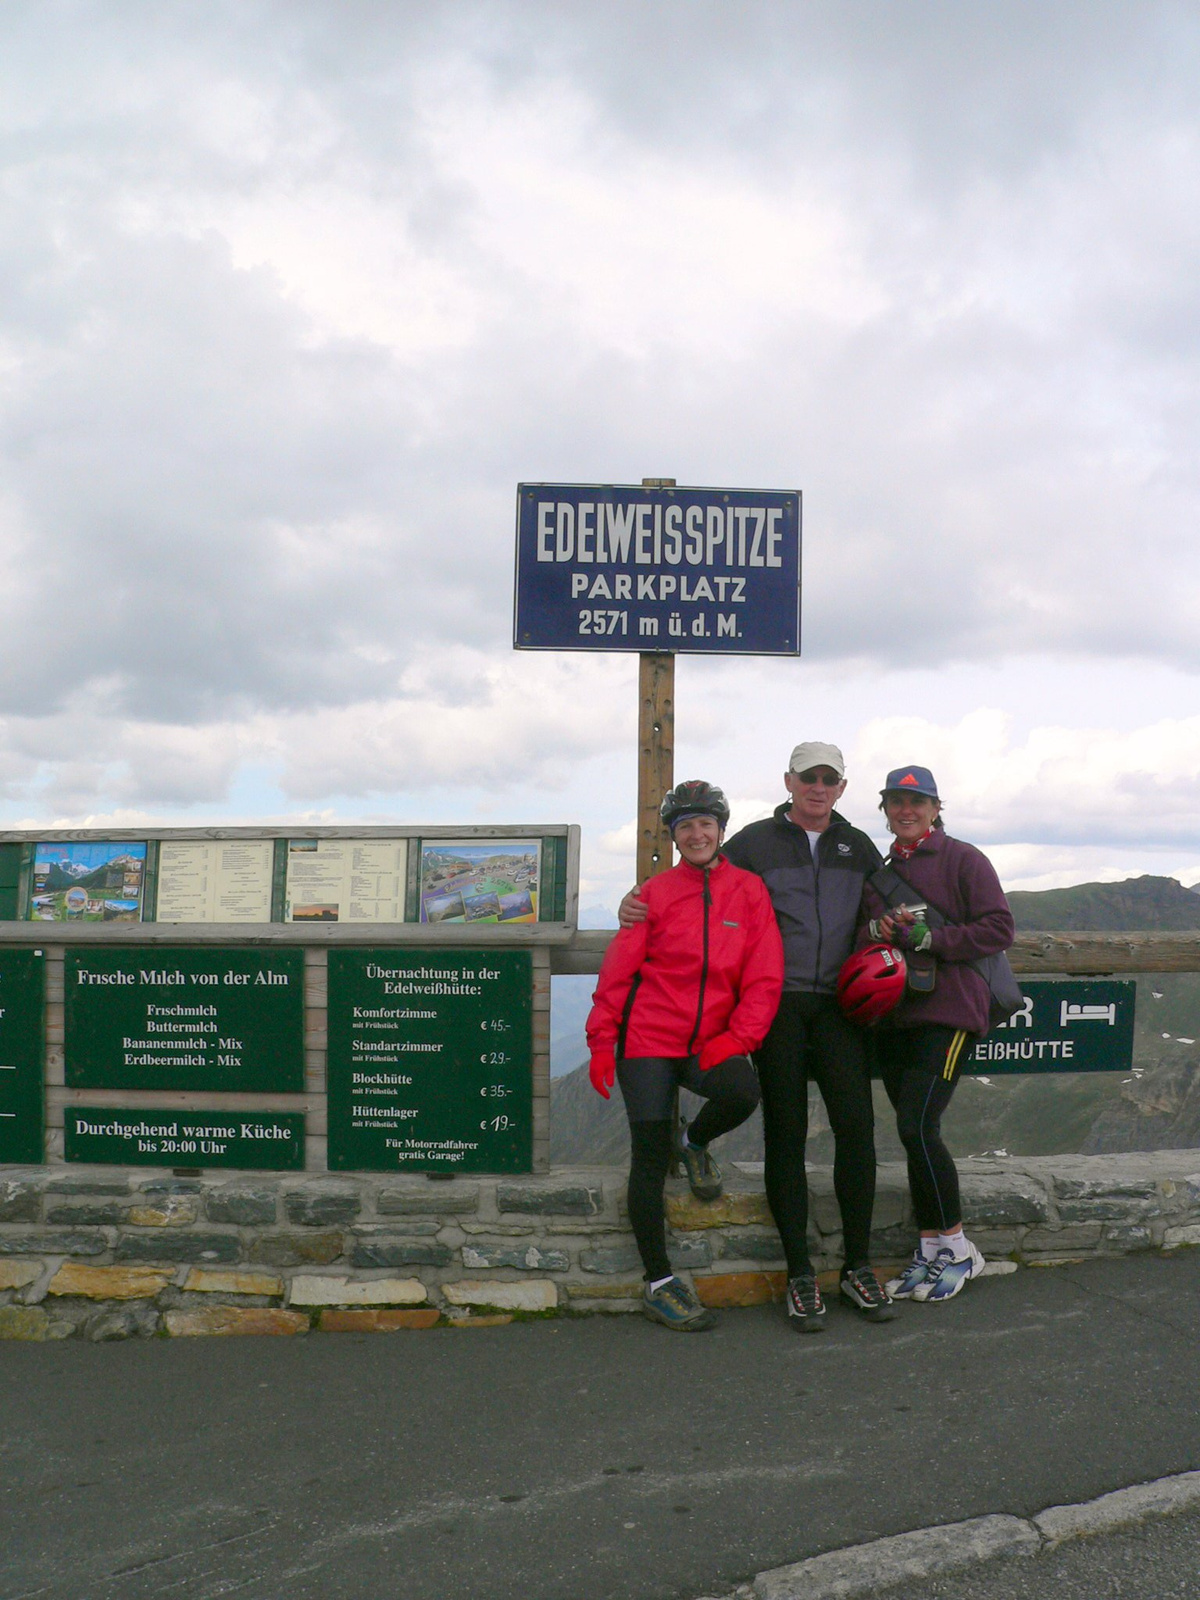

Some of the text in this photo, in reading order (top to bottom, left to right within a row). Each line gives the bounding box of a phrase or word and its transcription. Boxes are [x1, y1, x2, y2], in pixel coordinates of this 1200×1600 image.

[537, 501, 783, 568] EDELWEISSPITZE
[571, 573, 747, 603] PARKPLATZ
[578, 610, 743, 638] 2571 m ü. d. M.
[77, 969, 289, 985] Frische Milch von der Alm
[366, 963, 500, 982] Übernachtung in der
[384, 981, 482, 995] Edelweißhütte:
[147, 1004, 217, 1016] Frischmilch
[353, 1006, 438, 1019] Komfortzimme
[146, 1020, 218, 1033] Buttermilch
[352, 1021, 399, 1030] mit Frühstück
[480, 1020, 487, 1031] €
[122, 1037, 207, 1050] Bananenmilch
[218, 1037, 243, 1050] Mix
[352, 1039, 443, 1052] Standartzimmer
[124, 1053, 206, 1066] Erdbeermilch
[217, 1054, 242, 1067] Mix
[352, 1054, 399, 1063] mit Frühstück
[480, 1053, 487, 1064] €
[352, 1072, 413, 1085] Blockhütte
[352, 1087, 399, 1096] mit Frühstück
[480, 1086, 487, 1097] €
[352, 1105, 419, 1120] Hüttenlager
[75, 1120, 292, 1140] Durchgehend warme Küche
[352, 1120, 399, 1129] mit Frühstück
[480, 1119, 487, 1130] €
[138, 1140, 227, 1154] bis 20:00 Uhr
[386, 1138, 479, 1151] Für Motorradfahrer
[398, 1151, 465, 1162] gratis Garage!
